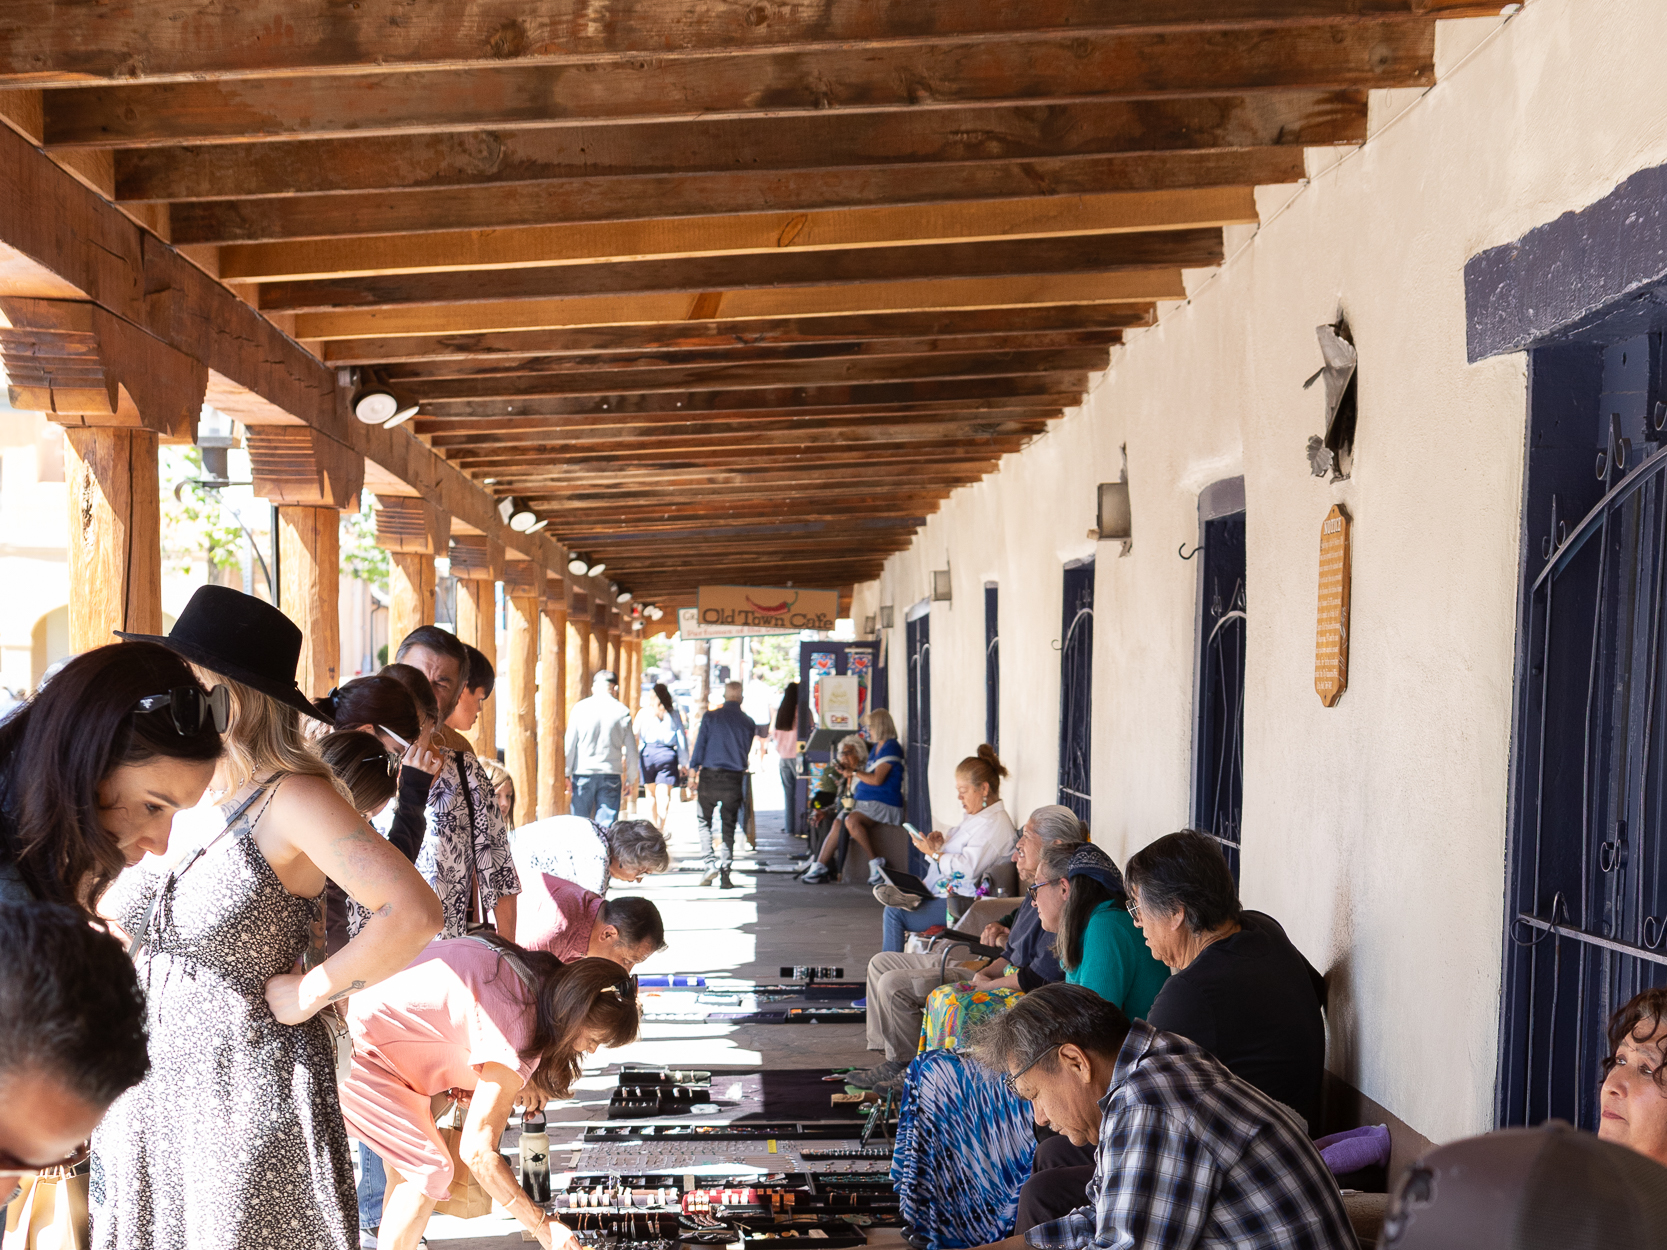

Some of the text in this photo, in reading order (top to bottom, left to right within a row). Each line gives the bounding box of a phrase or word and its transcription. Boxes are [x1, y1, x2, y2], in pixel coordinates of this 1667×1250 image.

[1324, 518, 1341, 535] NOTICE
[703, 608, 735, 624] Old
[738, 610, 785, 627] Town
[790, 613, 833, 628] Cafe
